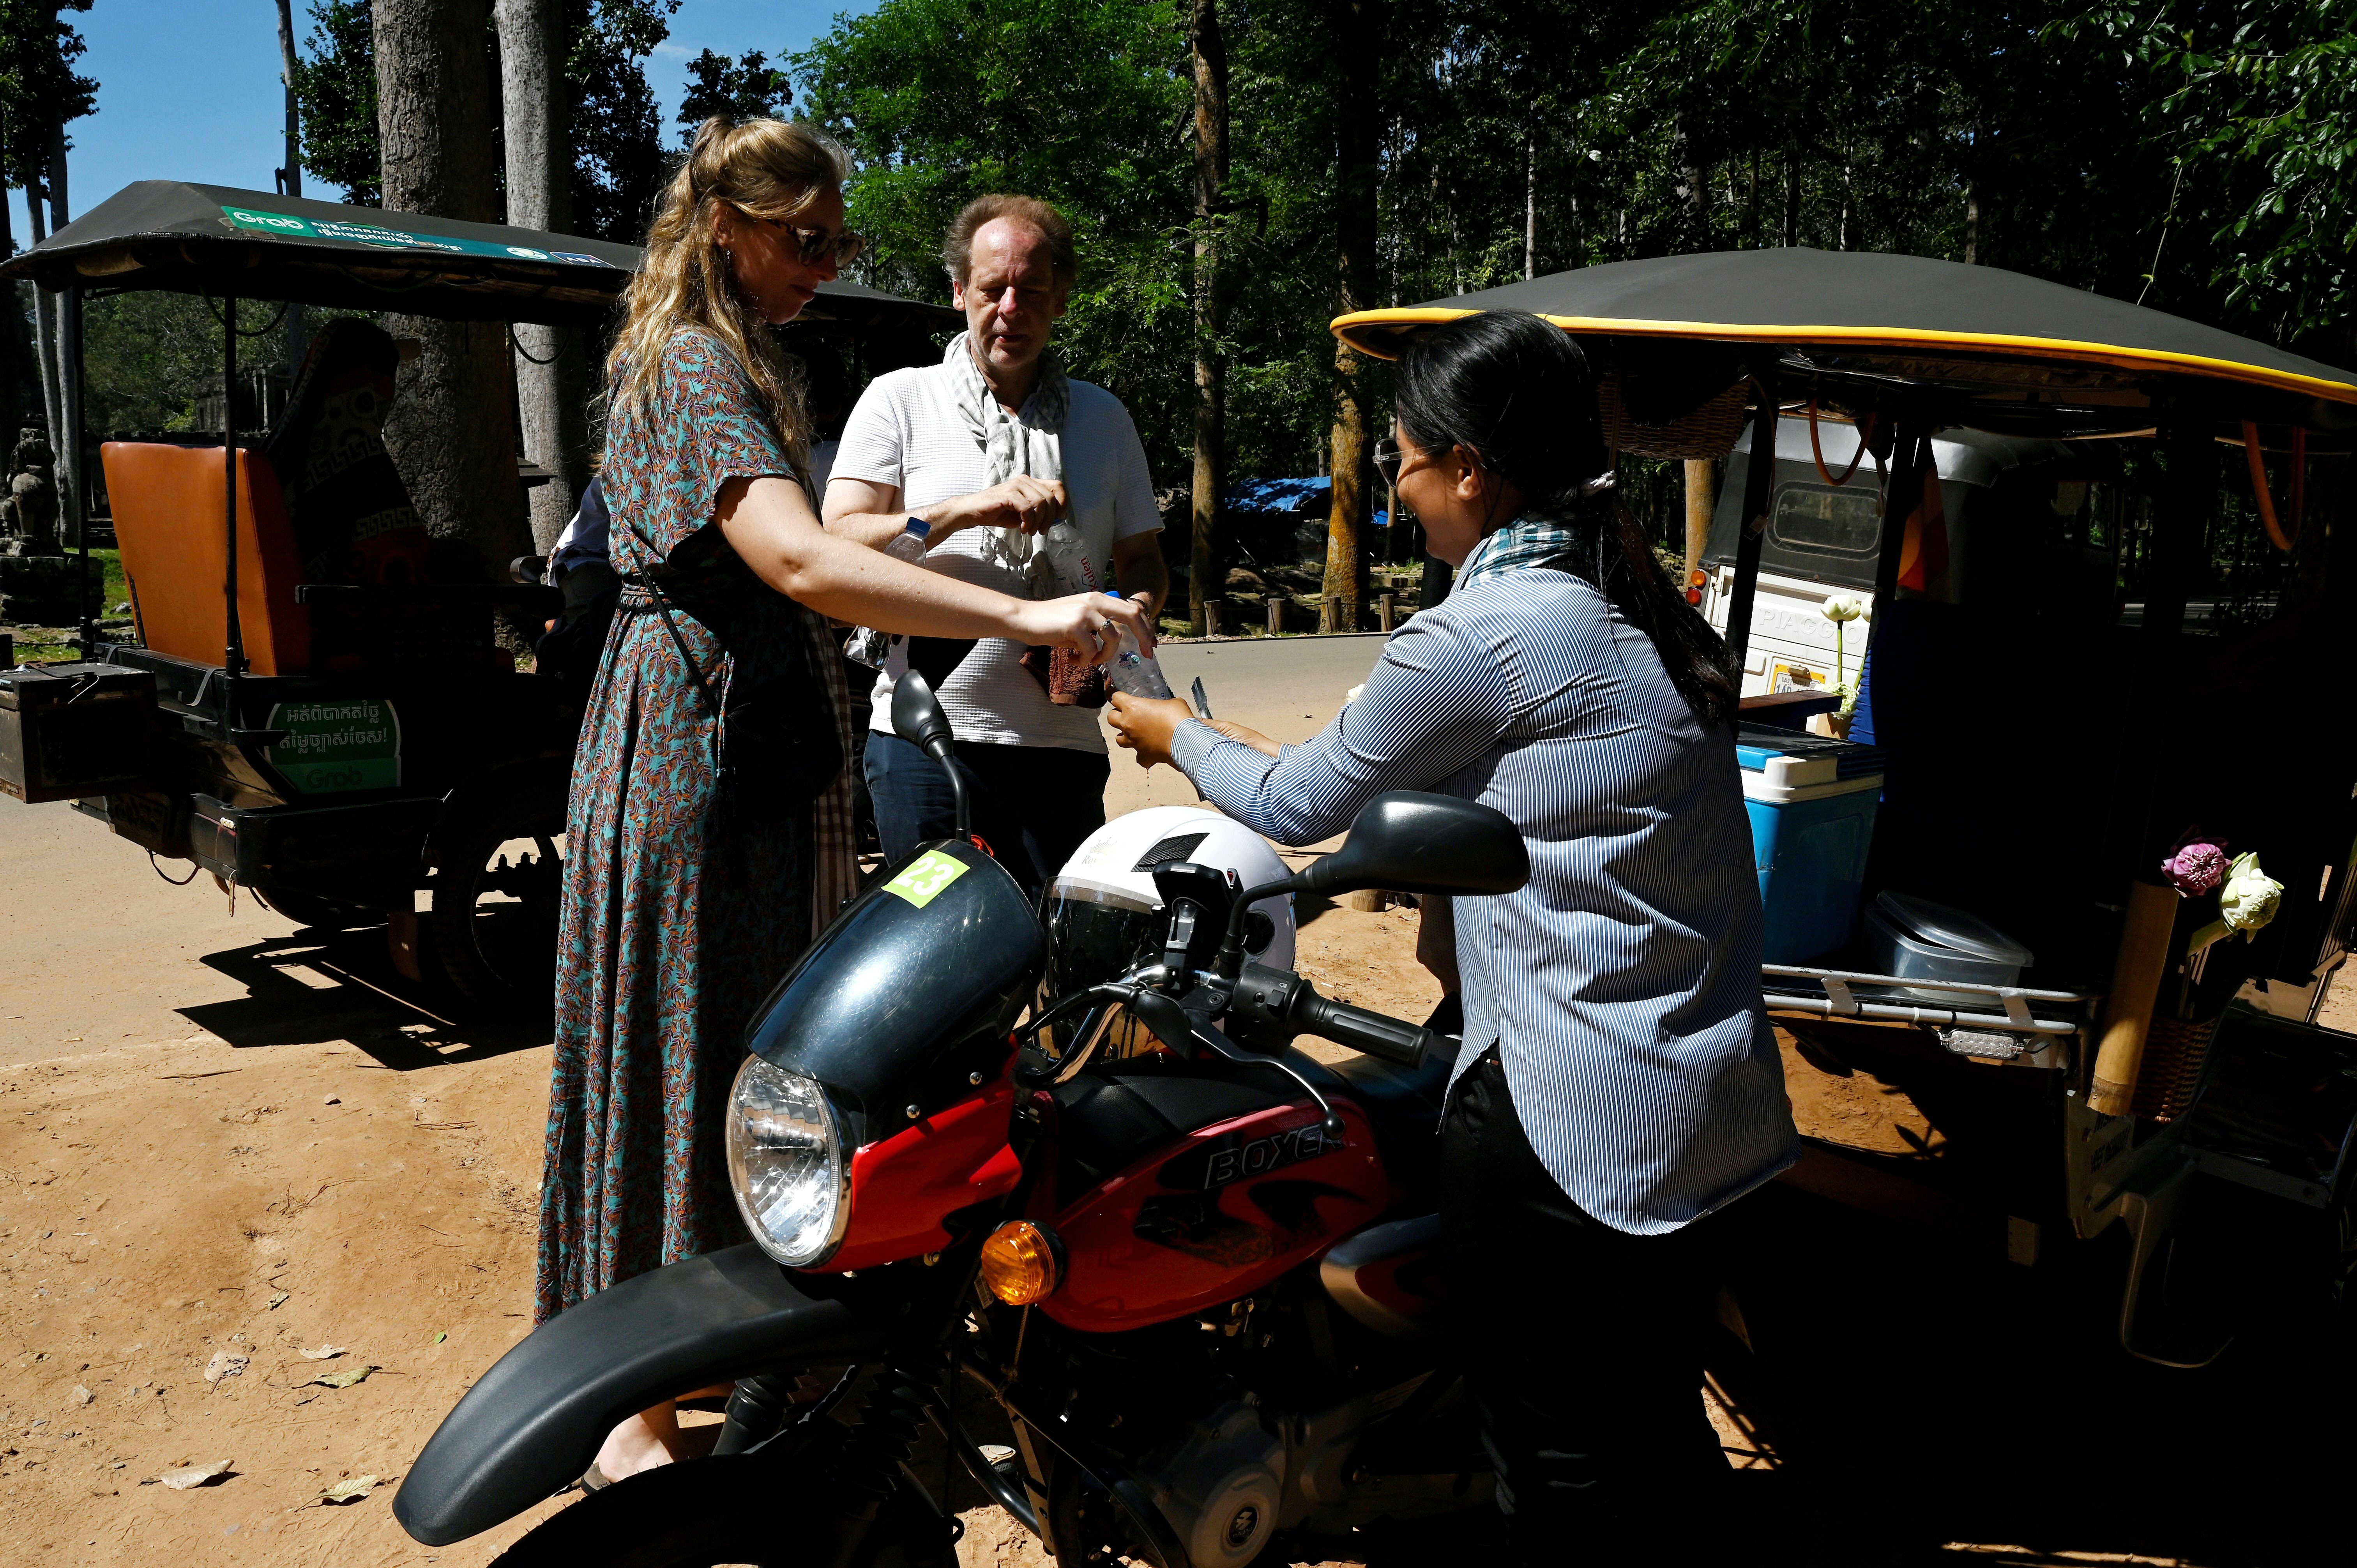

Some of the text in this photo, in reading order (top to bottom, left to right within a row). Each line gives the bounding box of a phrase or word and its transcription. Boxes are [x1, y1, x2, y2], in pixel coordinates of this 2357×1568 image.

[233, 212, 304, 229] Grab
[1081, 556, 1098, 591] Kulen
[1759, 607, 1862, 644] PIAGGO
[307, 765, 362, 788] Grab
[893, 857, 954, 895] 23
